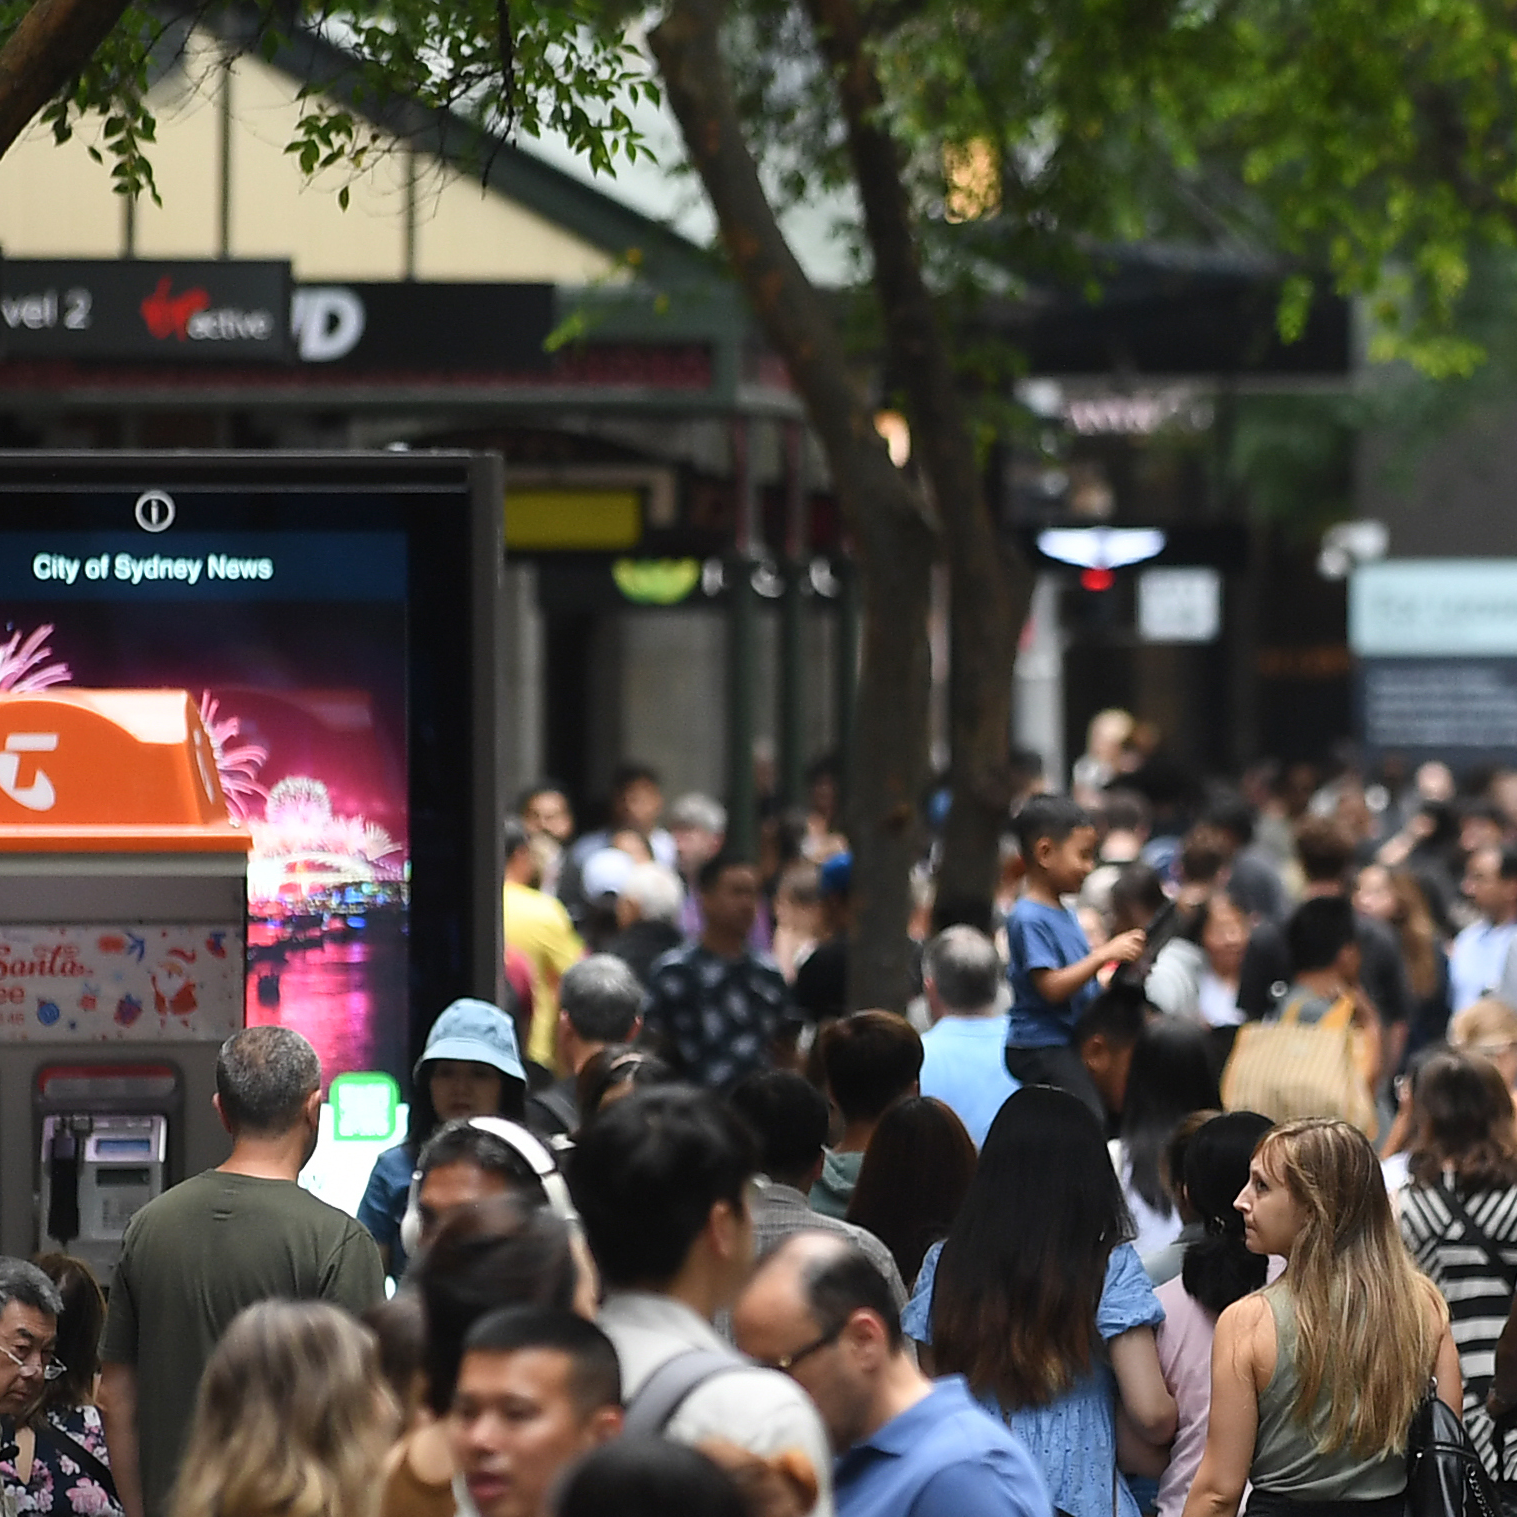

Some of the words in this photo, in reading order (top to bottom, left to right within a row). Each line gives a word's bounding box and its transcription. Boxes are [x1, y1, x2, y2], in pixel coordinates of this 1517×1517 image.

[63, 287, 92, 330] 2
[33, 553, 80, 585] City
[84, 553, 110, 580] of
[114, 553, 203, 585] Sydney
[207, 553, 274, 580] News
